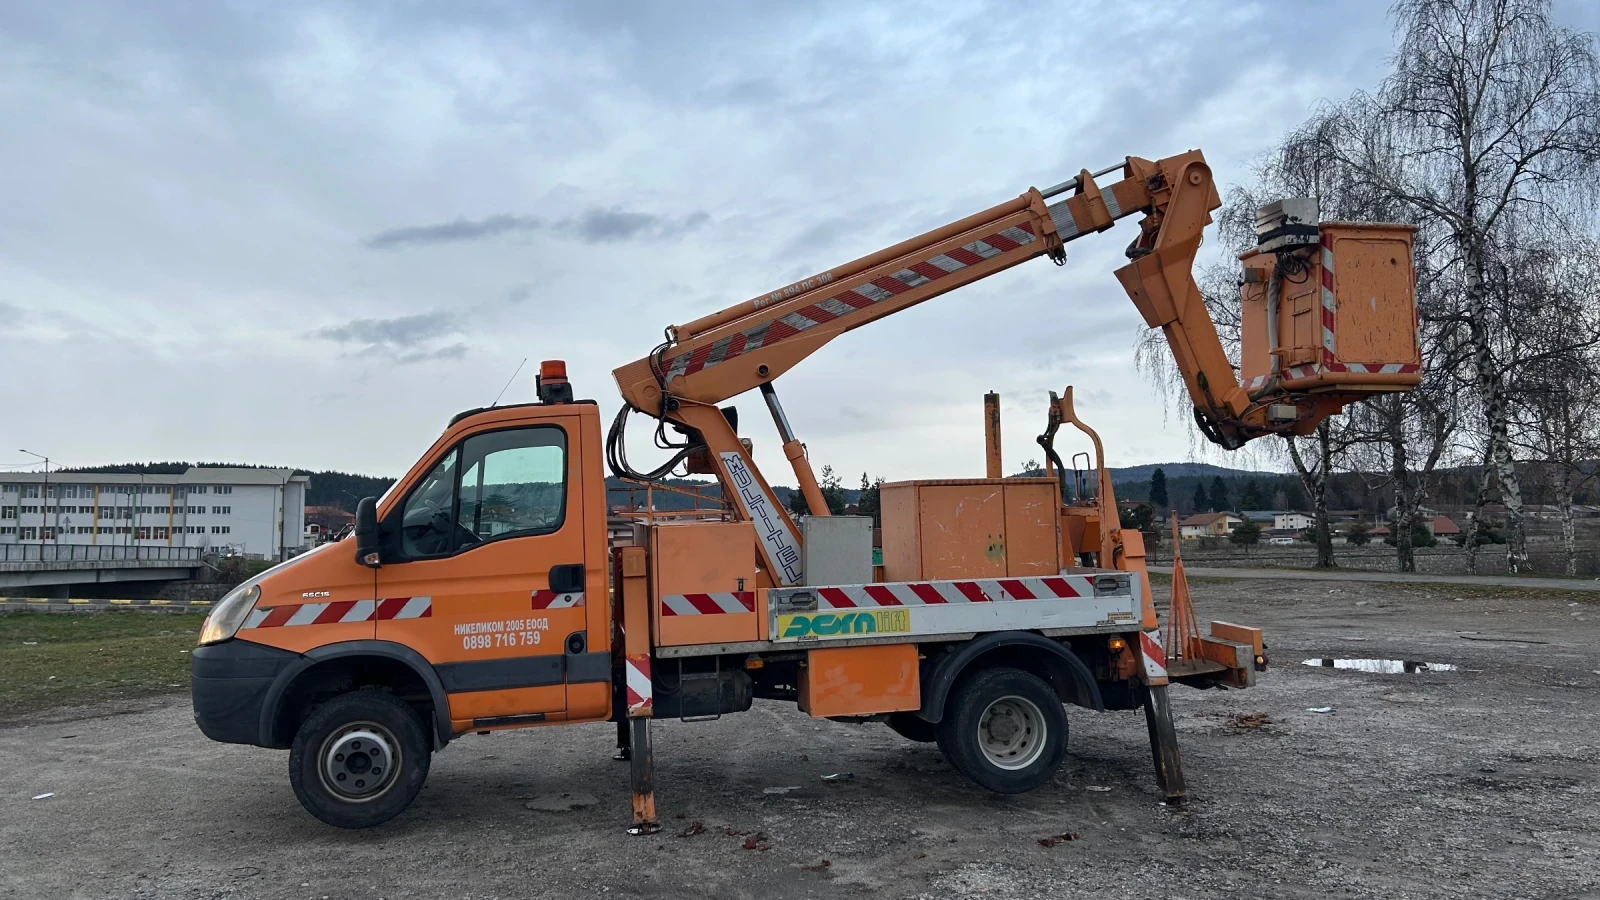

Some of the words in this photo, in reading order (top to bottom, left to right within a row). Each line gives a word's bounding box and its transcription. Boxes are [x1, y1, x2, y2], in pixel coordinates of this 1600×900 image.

[783, 285, 800, 297] 894
[802, 279, 815, 290] ПС
[816, 272, 832, 285] 308
[724, 453, 804, 584] MULTITEL
[454, 621, 504, 636] НИКЕЛИКОМ
[506, 619, 525, 632] 2005
[526, 617, 549, 631] ЕООД
[463, 634, 492, 650] 0898
[494, 632, 517, 648] 716
[519, 630, 541, 646] 759
